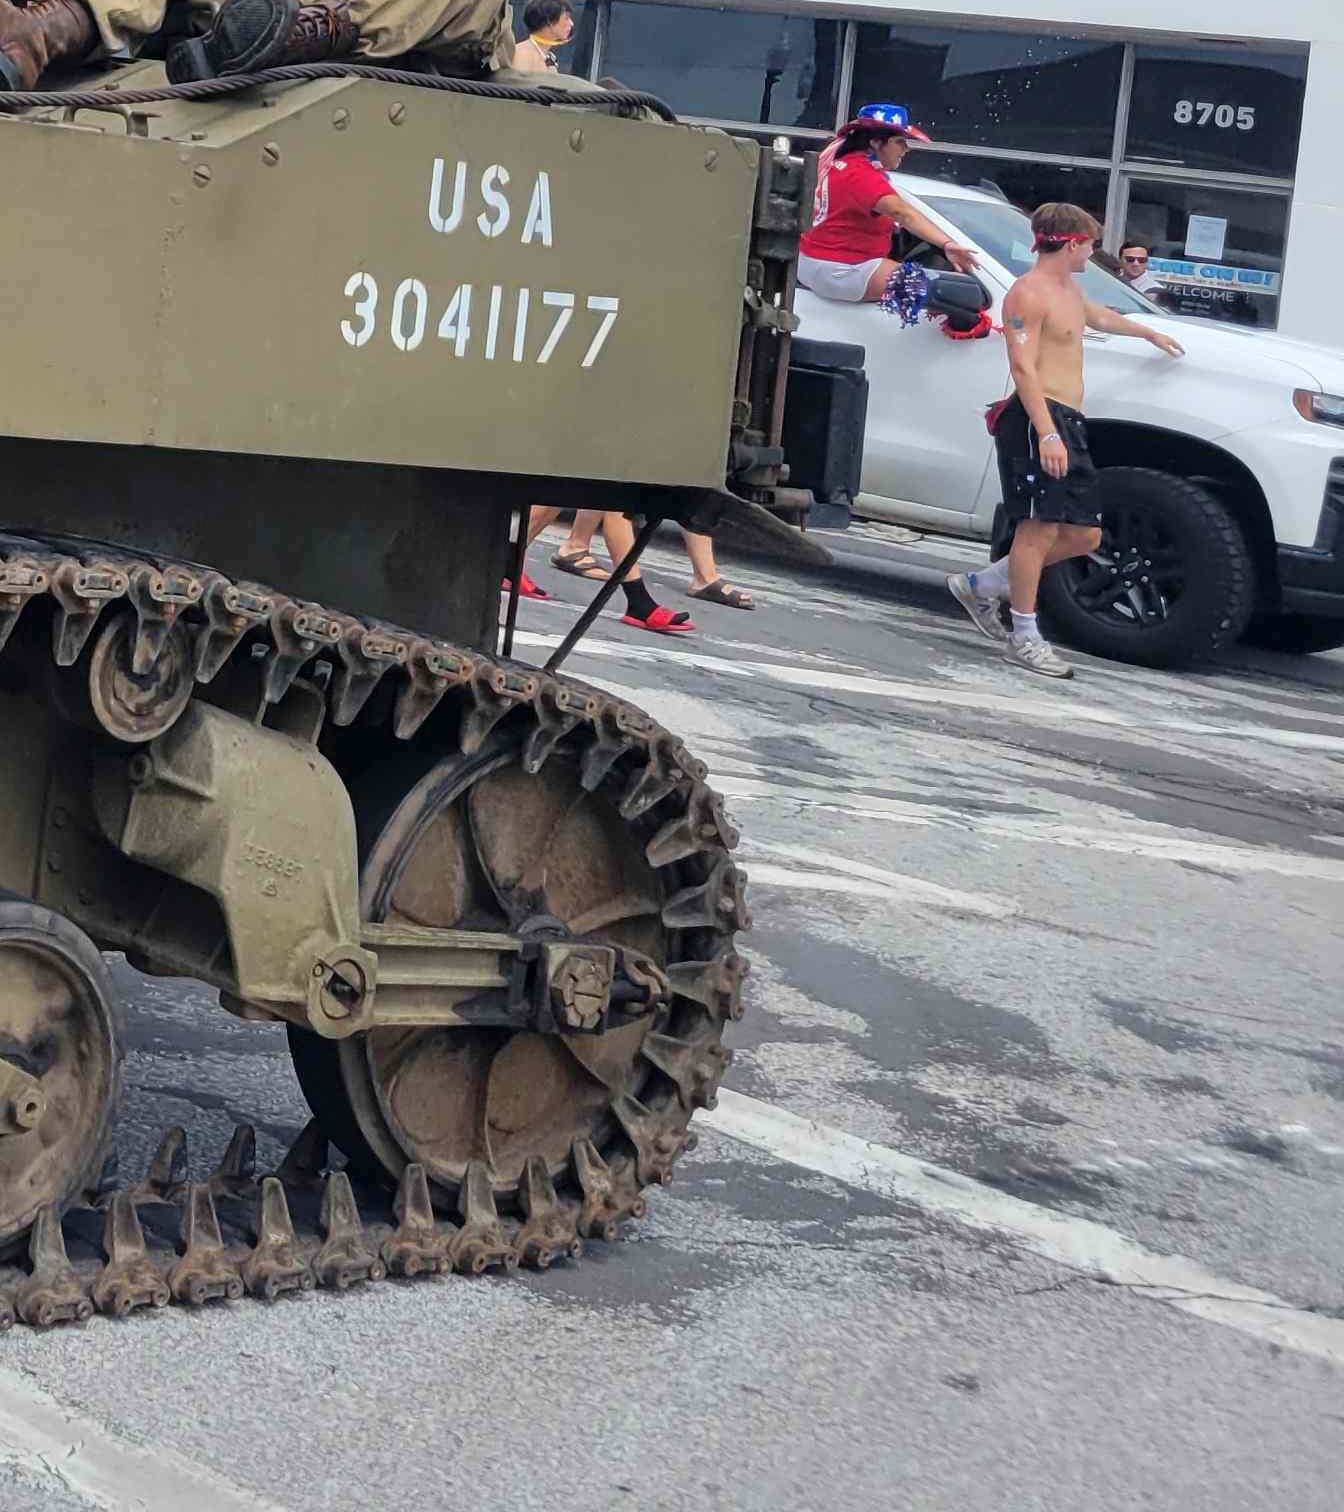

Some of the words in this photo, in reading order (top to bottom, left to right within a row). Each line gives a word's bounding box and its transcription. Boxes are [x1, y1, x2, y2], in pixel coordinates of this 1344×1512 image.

[1174, 100, 1255, 130] 8705
[429, 158, 552, 246] USA
[341, 272, 620, 367] 3041177
